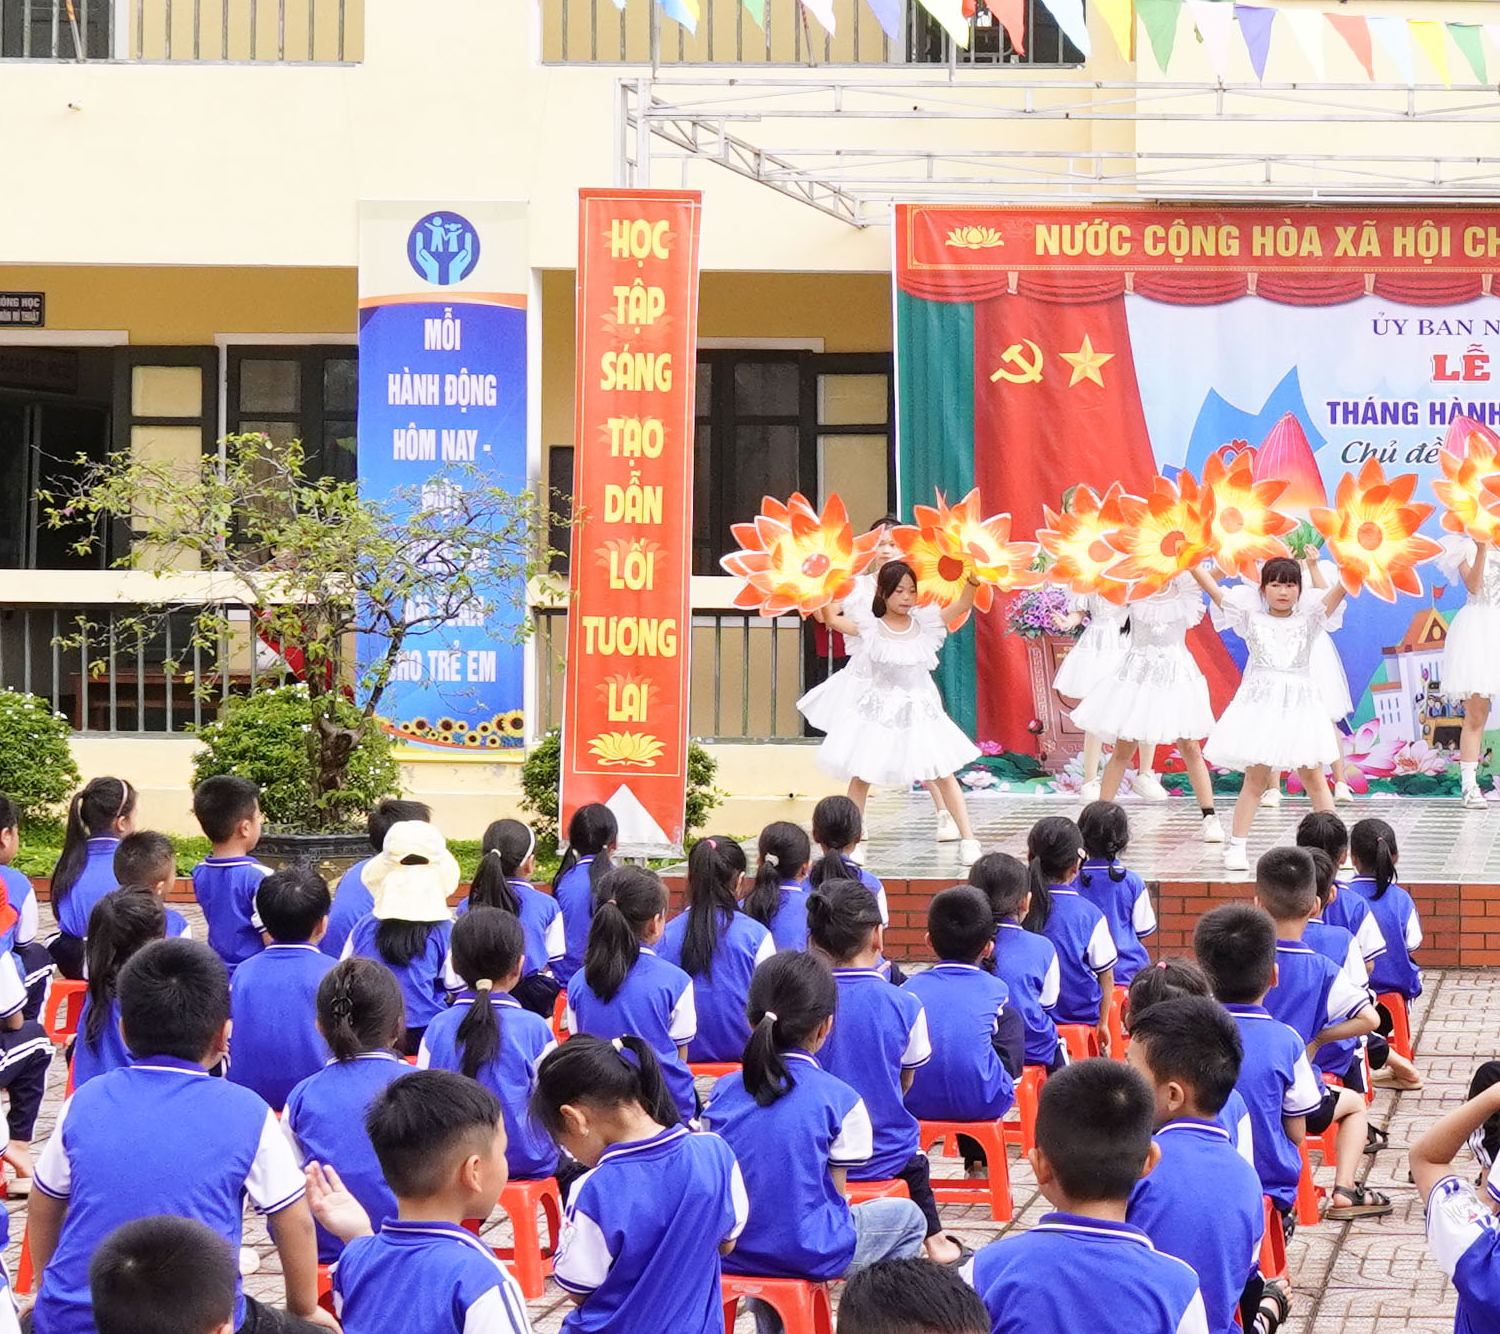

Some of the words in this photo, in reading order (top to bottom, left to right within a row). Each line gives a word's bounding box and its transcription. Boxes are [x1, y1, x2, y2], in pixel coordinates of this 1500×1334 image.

[611, 220, 670, 268] HỌC
[1035, 219, 1132, 256] NƯỚC
[1143, 219, 1240, 263] CỘNG
[1252, 219, 1323, 257] HÒA
[1334, 220, 1380, 257] XÃ
[1393, 220, 1451, 264] HỘI
[21, 297, 40, 309] HỌC
[612, 279, 665, 335] TẬP
[1372, 312, 1407, 336] ỦY
[1418, 319, 1473, 336] BAN
[424, 308, 461, 351] MỖI
[600, 341, 672, 392] SÁNG
[1432, 344, 1491, 382] LỄ
[387, 366, 439, 406] HÀNH
[444, 367, 497, 413] ĐỘNG
[1326, 396, 1418, 425] THÁNG
[393, 423, 436, 461] HÔM
[441, 429, 476, 462] NAY
[607, 417, 665, 467] TẠO
[1342, 440, 1397, 464] Chủ
[604, 470, 663, 525] DẪN
[609, 538, 654, 591] LỐI
[582, 617, 678, 658] TƯƠNG
[427, 640, 462, 682] TRẺ
[467, 650, 497, 683] EM
[608, 682, 649, 723] LAI
